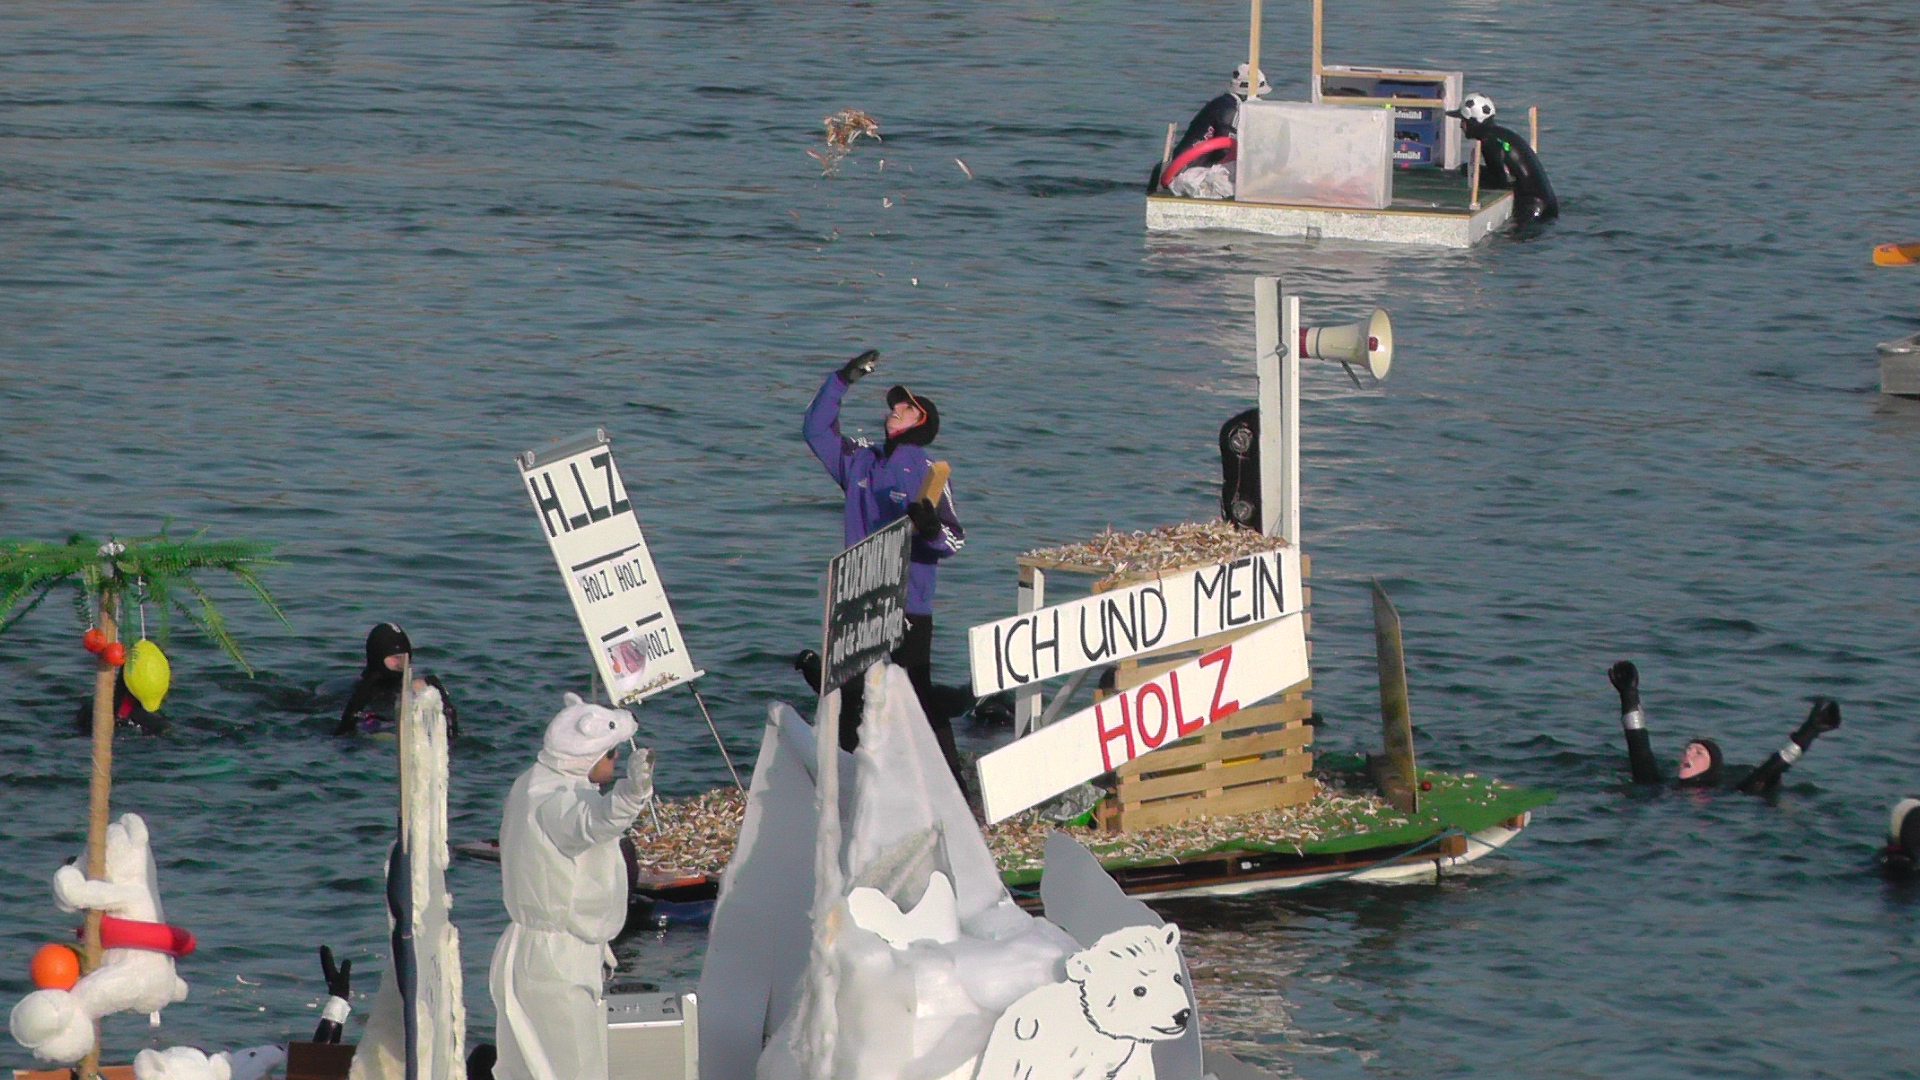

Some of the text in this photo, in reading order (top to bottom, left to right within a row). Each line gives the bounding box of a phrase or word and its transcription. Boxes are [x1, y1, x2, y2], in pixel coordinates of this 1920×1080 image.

[582, 558, 647, 603] HOLZ HOLZ
[994, 552, 1284, 689] ICH UND MEIN
[645, 627, 675, 662] HOLZ
[1094, 645, 1240, 772] HOLZ
